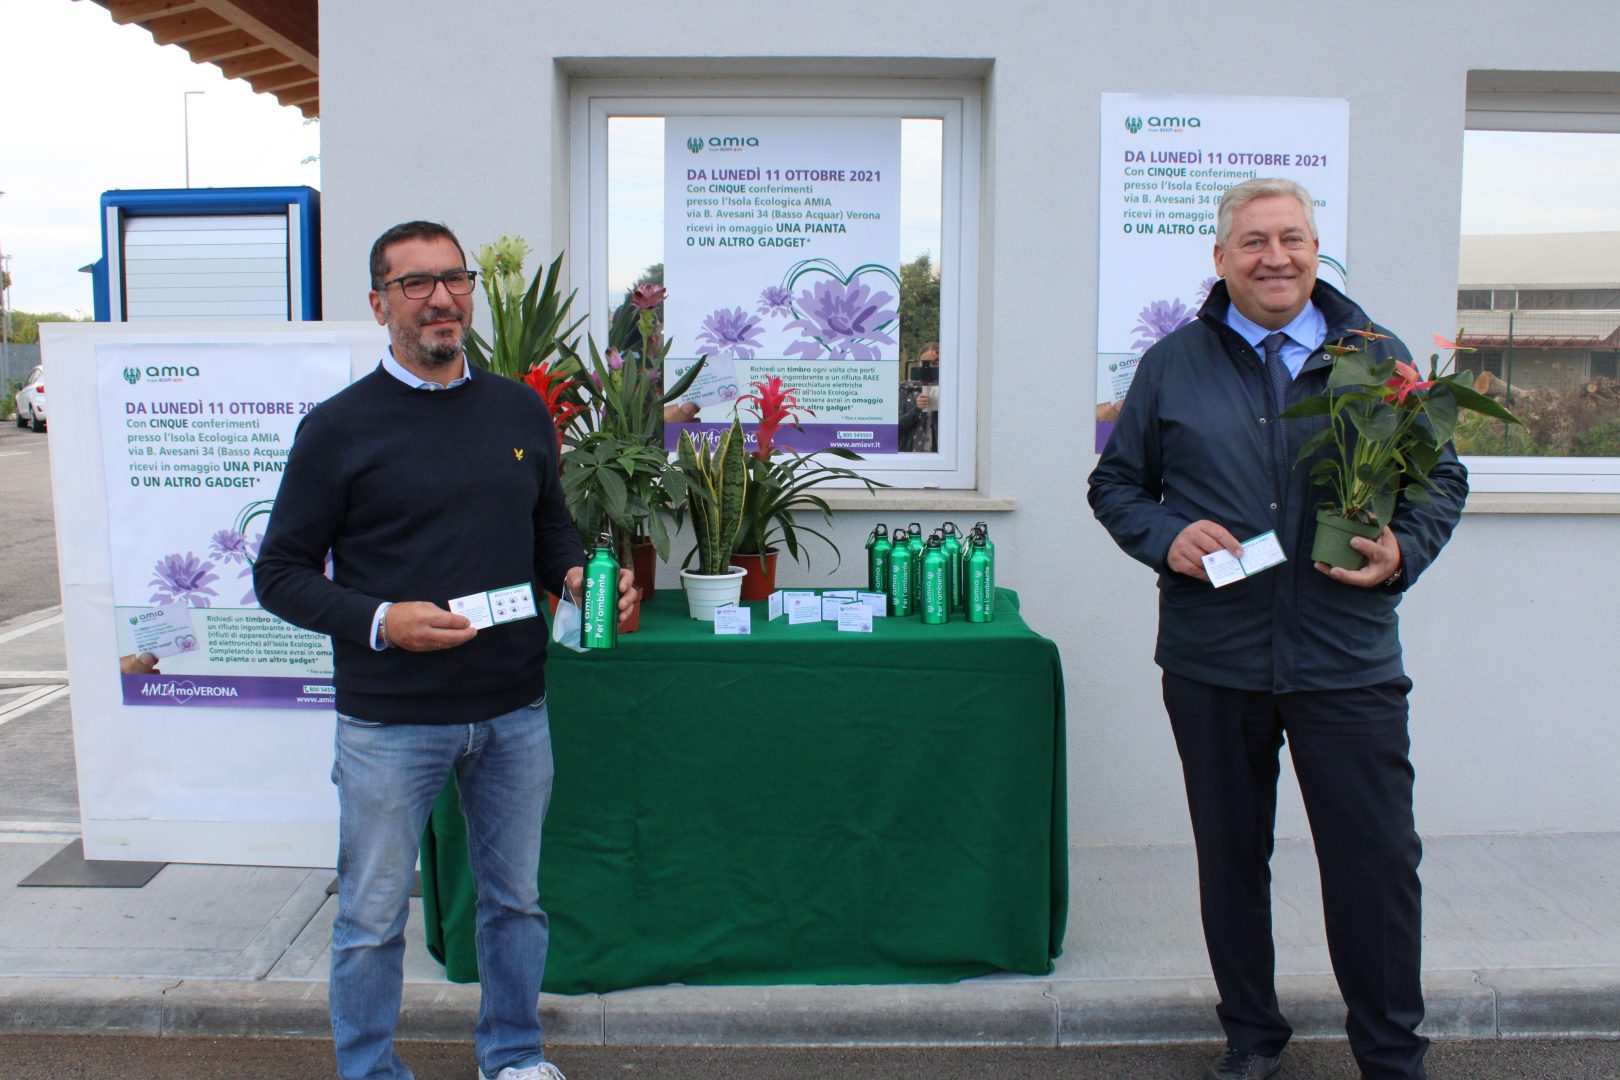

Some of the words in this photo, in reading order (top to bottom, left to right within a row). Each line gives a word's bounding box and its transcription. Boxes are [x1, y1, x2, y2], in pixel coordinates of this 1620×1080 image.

[1148, 116, 1200, 127] amia
[709, 137, 759, 147] amia
[1125, 151, 1145, 162] DA
[1150, 149, 1201, 164] LUNEDÌ
[1208, 153, 1222, 164] 11
[1228, 153, 1290, 165] OTTOBRE
[1295, 155, 1327, 166] 2021
[687, 169, 706, 180] DA
[712, 167, 760, 180] LUNEDÌ
[766, 170, 779, 180] 11
[785, 170, 845, 181] OTTOBRE
[850, 171, 880, 182] 2021
[1124, 167, 1144, 176] Con
[1148, 168, 1186, 178] CINQUE
[1190, 169, 1256, 178] conferimenti
[687, 184, 705, 193] Con
[709, 184, 746, 194] CINQUE
[749, 184, 812, 193] conferimenti
[1124, 182, 1157, 191] presso
[1162, 181, 1192, 190] l'Isola
[1196, 183, 1232, 192] Ecologi
[687, 199, 718, 208] presso
[722, 198, 751, 206] l'Isola
[755, 198, 801, 208] Ecologica
[1124, 195, 1139, 203] via
[1142, 195, 1151, 203] B.
[1155, 195, 1194, 204] Avesani
[1198, 195, 1209, 204] 34
[687, 210, 700, 218] via
[716, 210, 753, 218] Avesani
[757, 210, 768, 219] 34
[772, 210, 802, 220] (Basso
[806, 210, 843, 221] Acquar)
[847, 211, 880, 220] Verona
[1124, 210, 1152, 218] ricevi
[1155, 210, 1165, 218] in
[1168, 211, 1214, 221] omaggio
[687, 224, 713, 232] ricevi
[717, 224, 726, 232] in
[729, 224, 772, 234] omaggio
[776, 224, 801, 233] UNA
[805, 224, 846, 233] PIANTA
[1124, 224, 1132, 233] O
[1136, 224, 1153, 234] UN
[1157, 224, 1194, 234] ALTRO
[687, 237, 694, 246] O
[699, 237, 715, 246] UN
[718, 237, 754, 247] ALTRO
[146, 366, 199, 377] amia
[126, 403, 146, 414] DA
[152, 400, 203, 414] LUNEDÌ
[209, 403, 224, 414] 11
[229, 403, 294, 414] OTTOBRE
[299, 403, 315, 414] 20
[127, 419, 146, 428] Con
[150, 419, 188, 429] CINQUE
[192, 419, 260, 428] conferimenti
[128, 433, 161, 443] presso
[165, 433, 195, 442] l'Isola
[199, 433, 247, 443] Ecologica
[251, 433, 280, 442] AMIA
[128, 447, 144, 456] via
[147, 447, 156, 456] B.
[159, 447, 199, 456] Avesani
[202, 447, 214, 456] 34
[218, 447, 250, 458] (Basso
[254, 448, 289, 458] Acquar
[130, 462, 158, 471] ricevi
[161, 462, 170, 471] in
[174, 462, 220, 473] omaggio
[224, 462, 249, 471] UNA
[253, 462, 286, 472] PIAN
[131, 477, 139, 487] O
[144, 477, 160, 487] UN
[165, 477, 201, 487] ALTRO
[596, 574, 606, 621] l'ambiente
[140, 610, 164, 620] amia
[141, 682, 238, 696] AMIAmoVERONA
